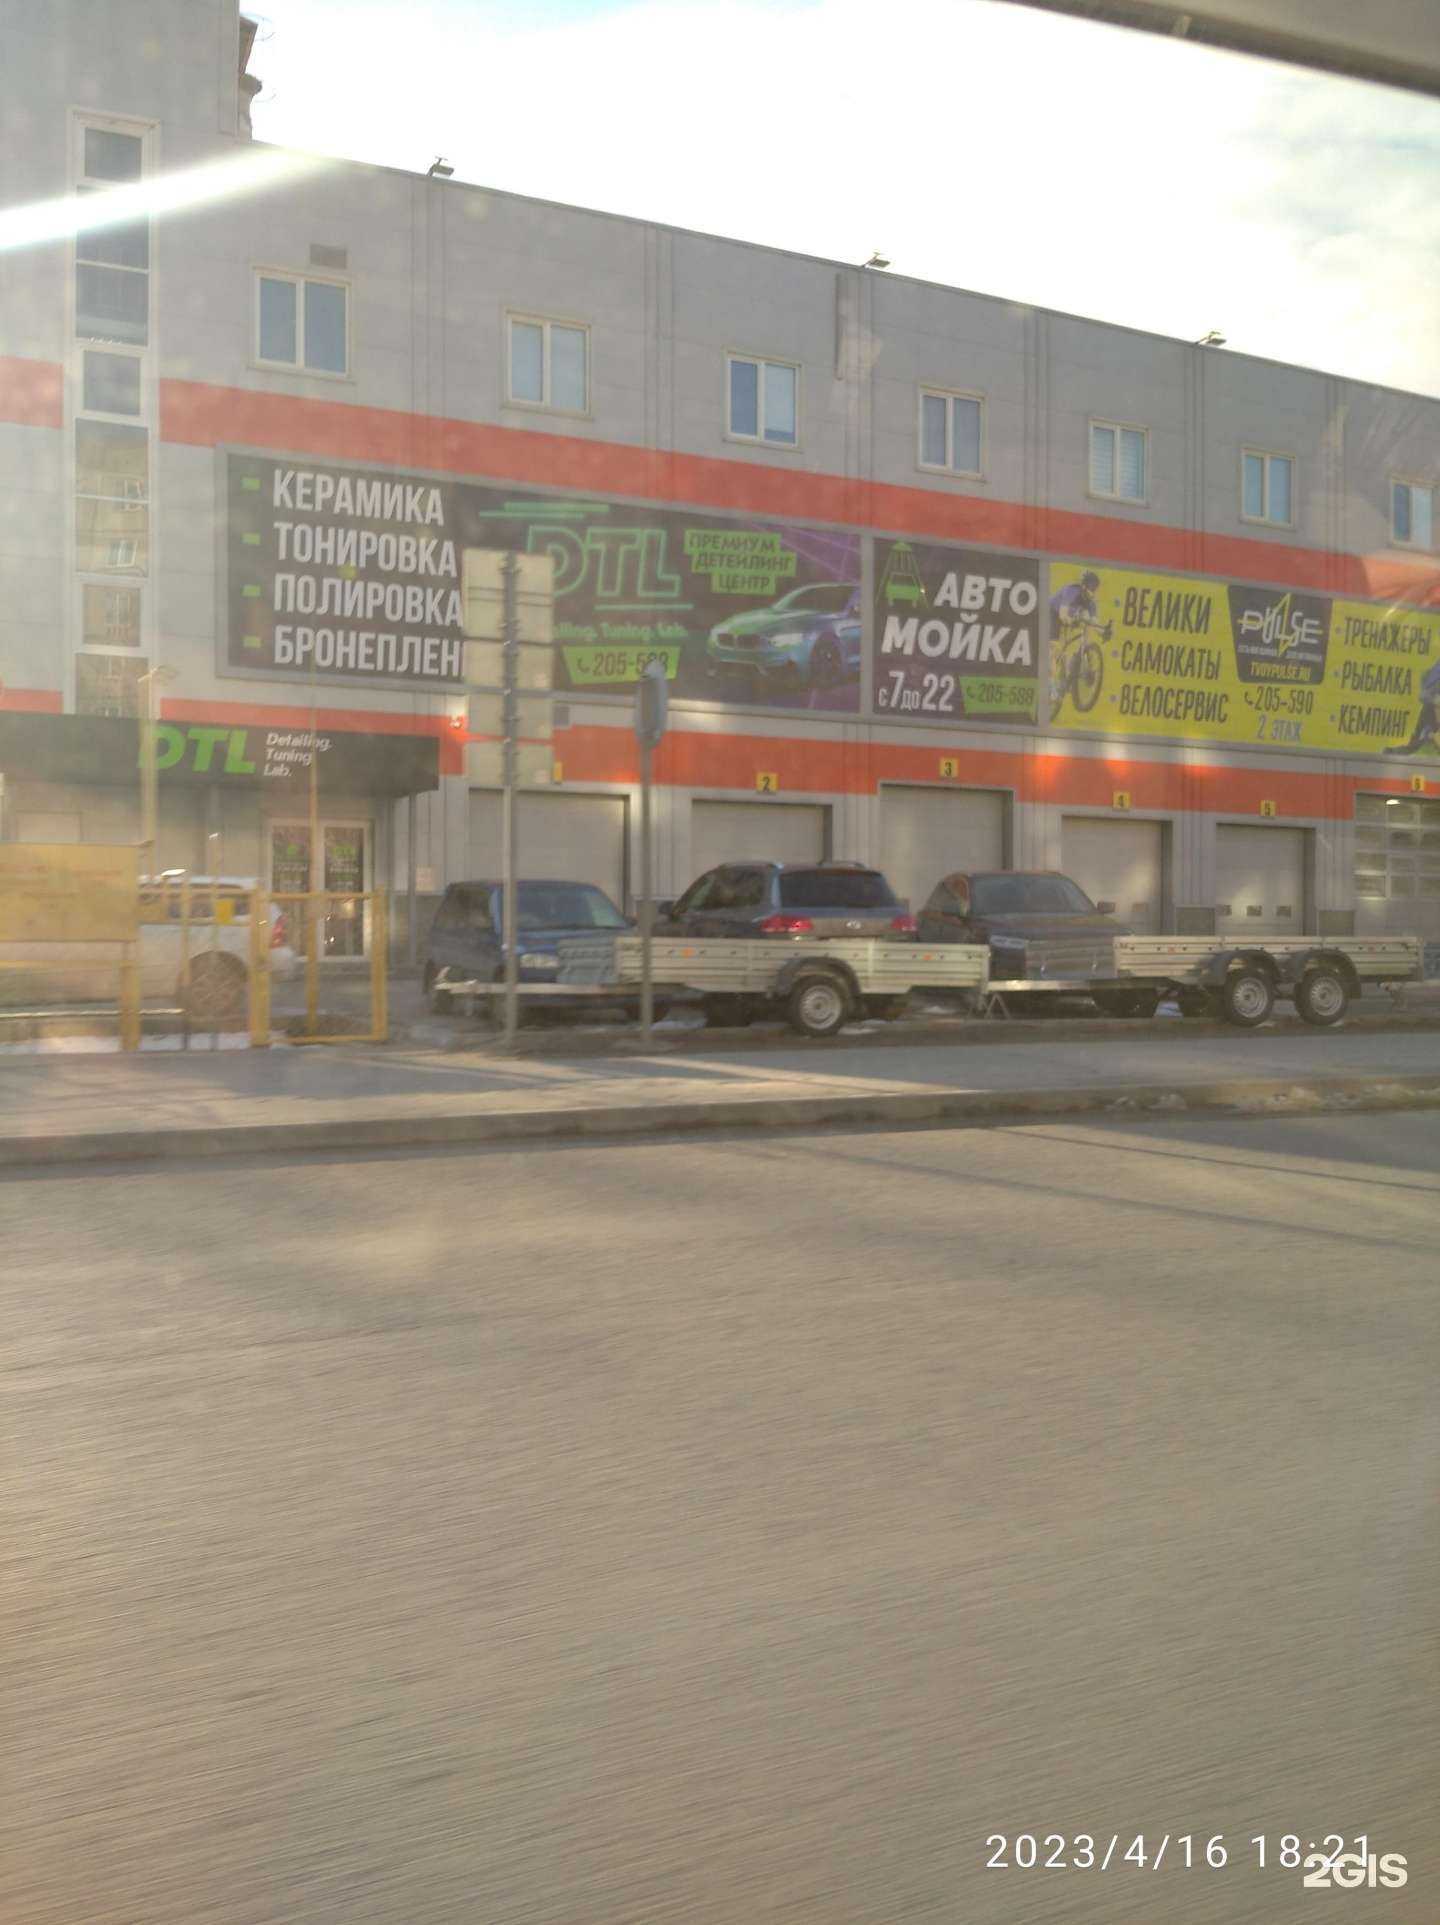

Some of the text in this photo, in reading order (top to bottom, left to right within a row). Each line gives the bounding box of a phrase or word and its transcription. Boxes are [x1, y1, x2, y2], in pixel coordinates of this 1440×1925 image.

[272, 468, 445, 527] КЕРАМИКА
[273, 521, 458, 578] ТОНИРОВКА
[527, 525, 682, 597] DTL
[690, 534, 776, 554] ПРЕМИУМ
[273, 572, 464, 628] ПОЛИРОВКА
[719, 574, 771, 591] ЦЕНТР
[933, 572, 1038, 616] АВТО
[1122, 586, 1212, 635] ВЕЛИКИ
[1238, 600, 1324, 650] PULSE
[273, 624, 465, 677] БРОНЕПЛЕН
[880, 612, 1032, 666] МОЙКА
[1343, 616, 1432, 655] ТРЕНАЖЕРЫ
[1120, 639, 1221, 681] САМОКАТЫ
[1341, 659, 1412, 695] РЫБАЛКА
[921, 673, 954, 712] 22
[1119, 683, 1229, 724] ВЕЛОСЕРВИС
[1254, 685, 1314, 715] 205-590
[1257, 714, 1266, 739] 2
[1338, 703, 1411, 738] КЕМПИНГ
[137, 725, 257, 774] DTL
[944, 761, 953, 777] 3
[761, 775, 771, 792] 2
